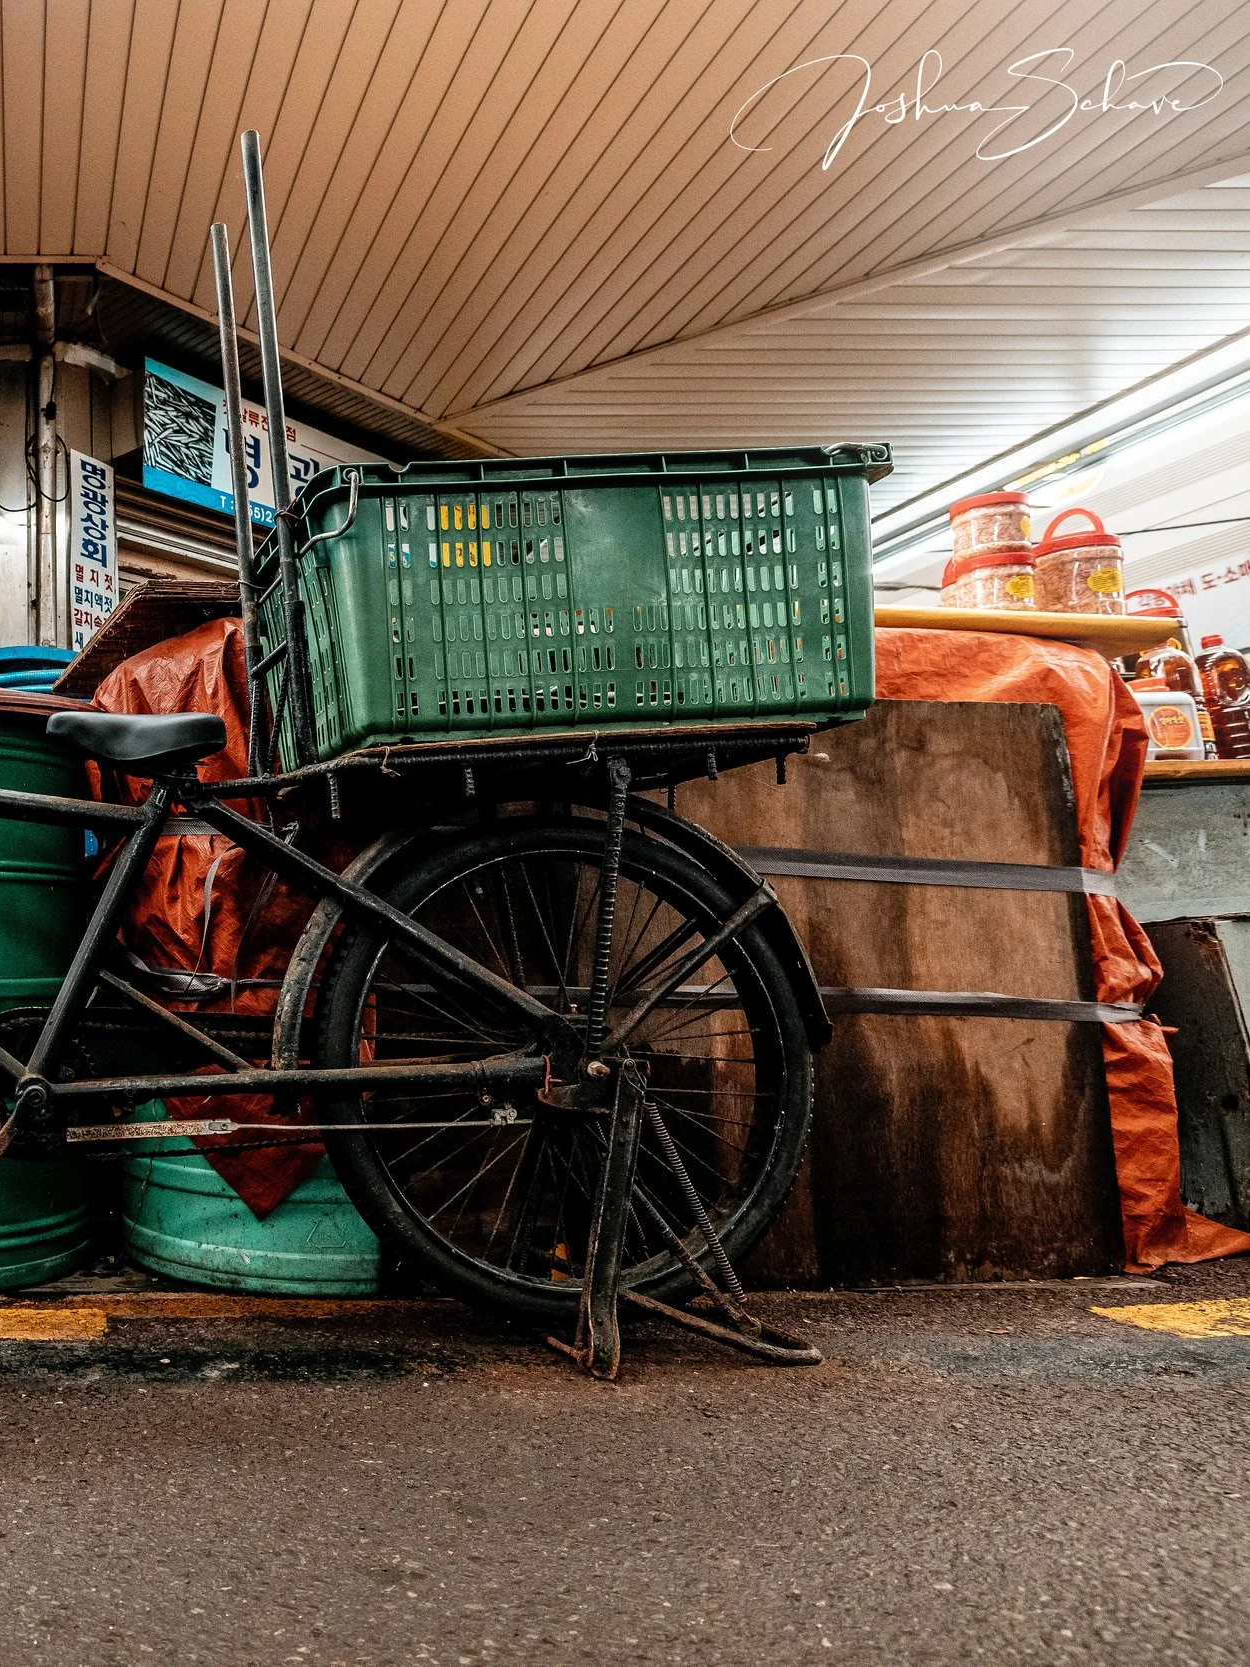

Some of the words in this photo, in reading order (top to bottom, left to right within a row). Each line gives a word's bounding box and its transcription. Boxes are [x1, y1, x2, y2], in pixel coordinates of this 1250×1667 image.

[80, 458, 108, 569] 명광상회
[74, 585, 113, 614] 멸치액젓
[73, 608, 108, 631] 갈치속
